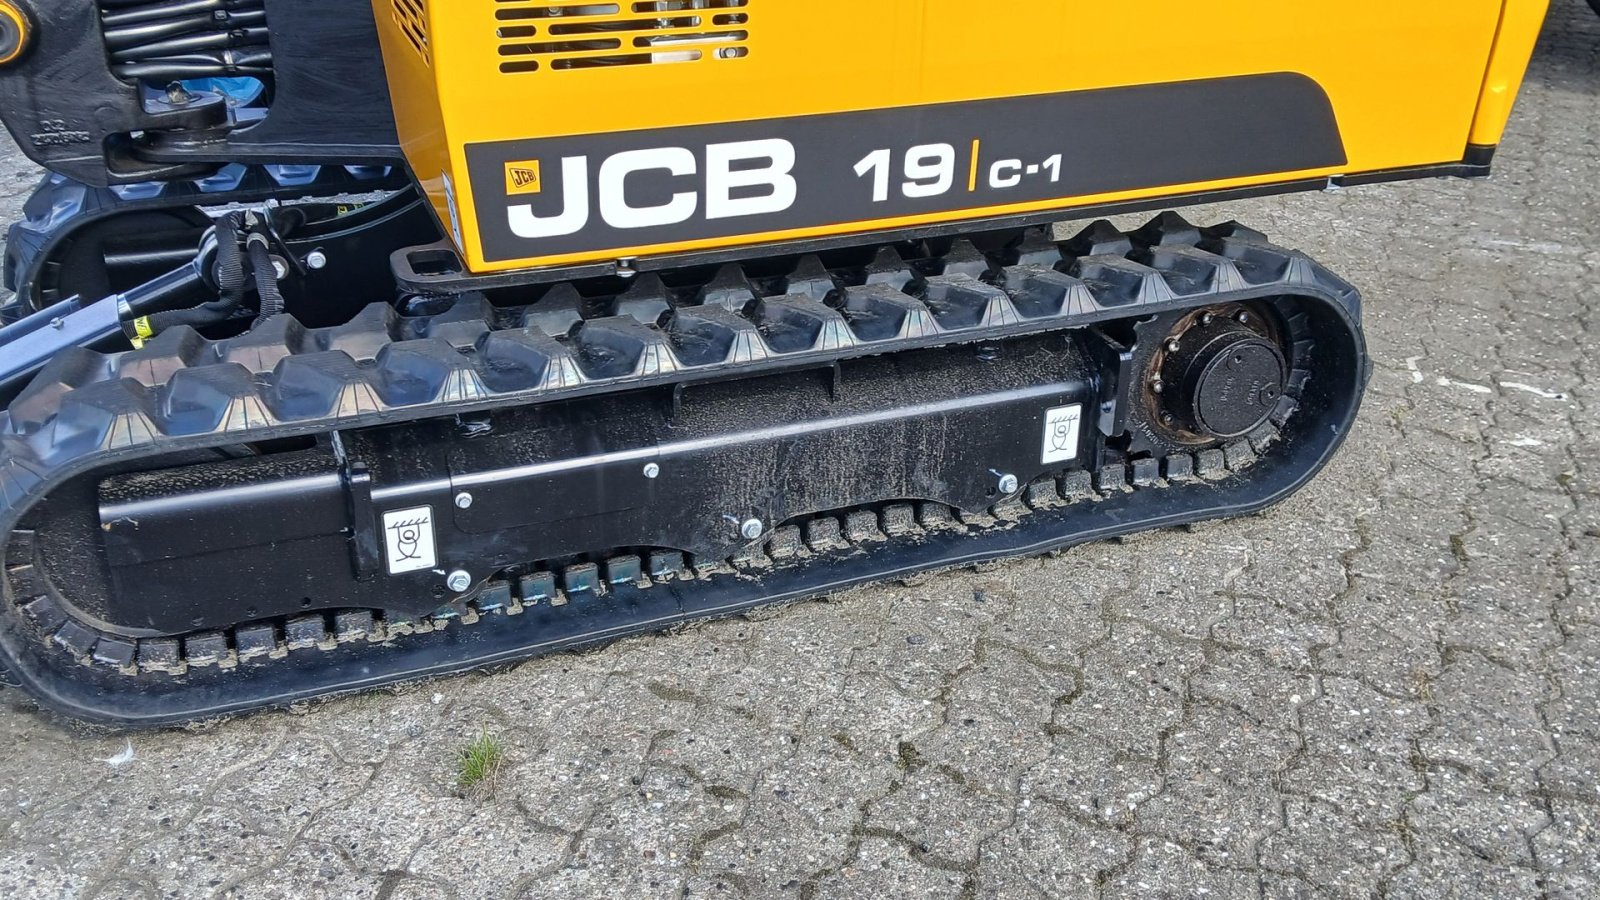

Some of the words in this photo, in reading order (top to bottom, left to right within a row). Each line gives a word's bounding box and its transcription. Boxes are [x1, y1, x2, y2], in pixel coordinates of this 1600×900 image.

[507, 138, 797, 239] JCB
[853, 142, 956, 203] 19
[514, 170, 535, 186] JCB
